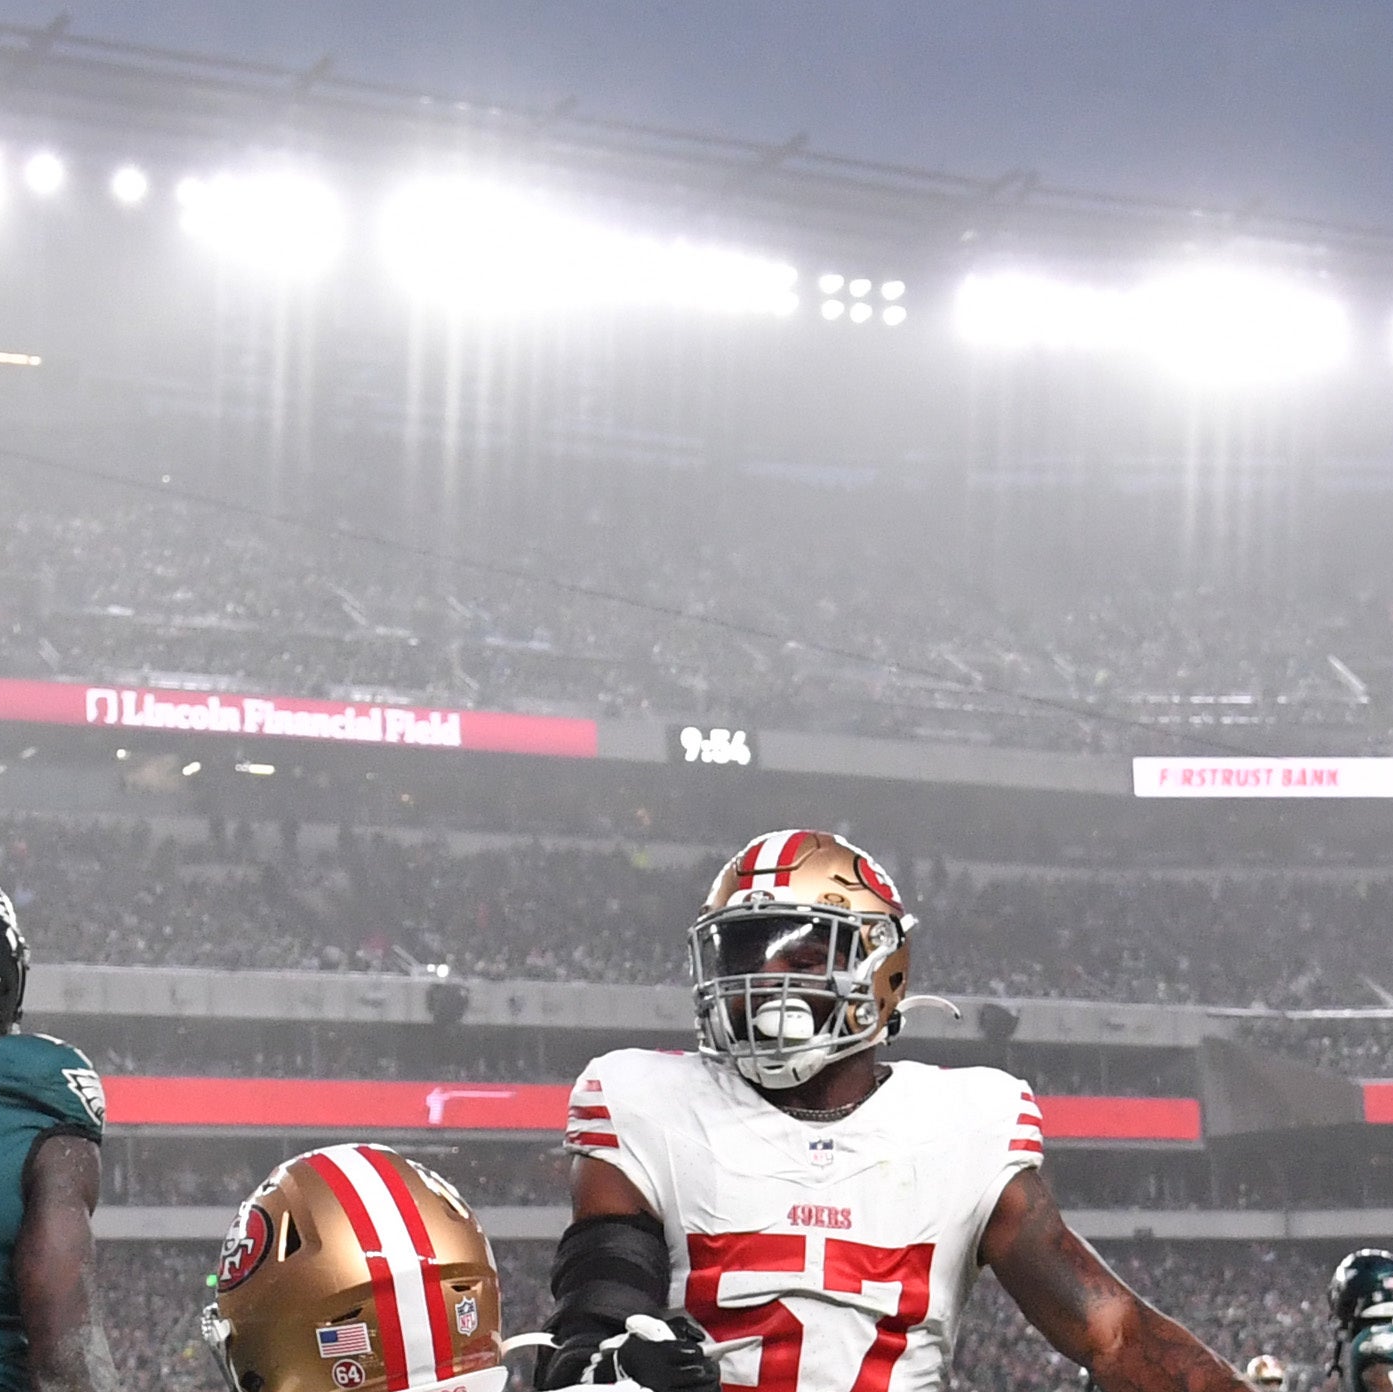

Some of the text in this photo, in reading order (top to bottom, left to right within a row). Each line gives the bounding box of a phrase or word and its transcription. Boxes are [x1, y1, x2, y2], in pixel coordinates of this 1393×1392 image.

[121, 690, 462, 747] Lincoln Financial Field
[1160, 768, 1339, 787] FRSTRUST BANK
[787, 1204, 852, 1230] 49ERS
[460, 1313, 475, 1331] NFL
[335, 1365, 362, 1385] 64
